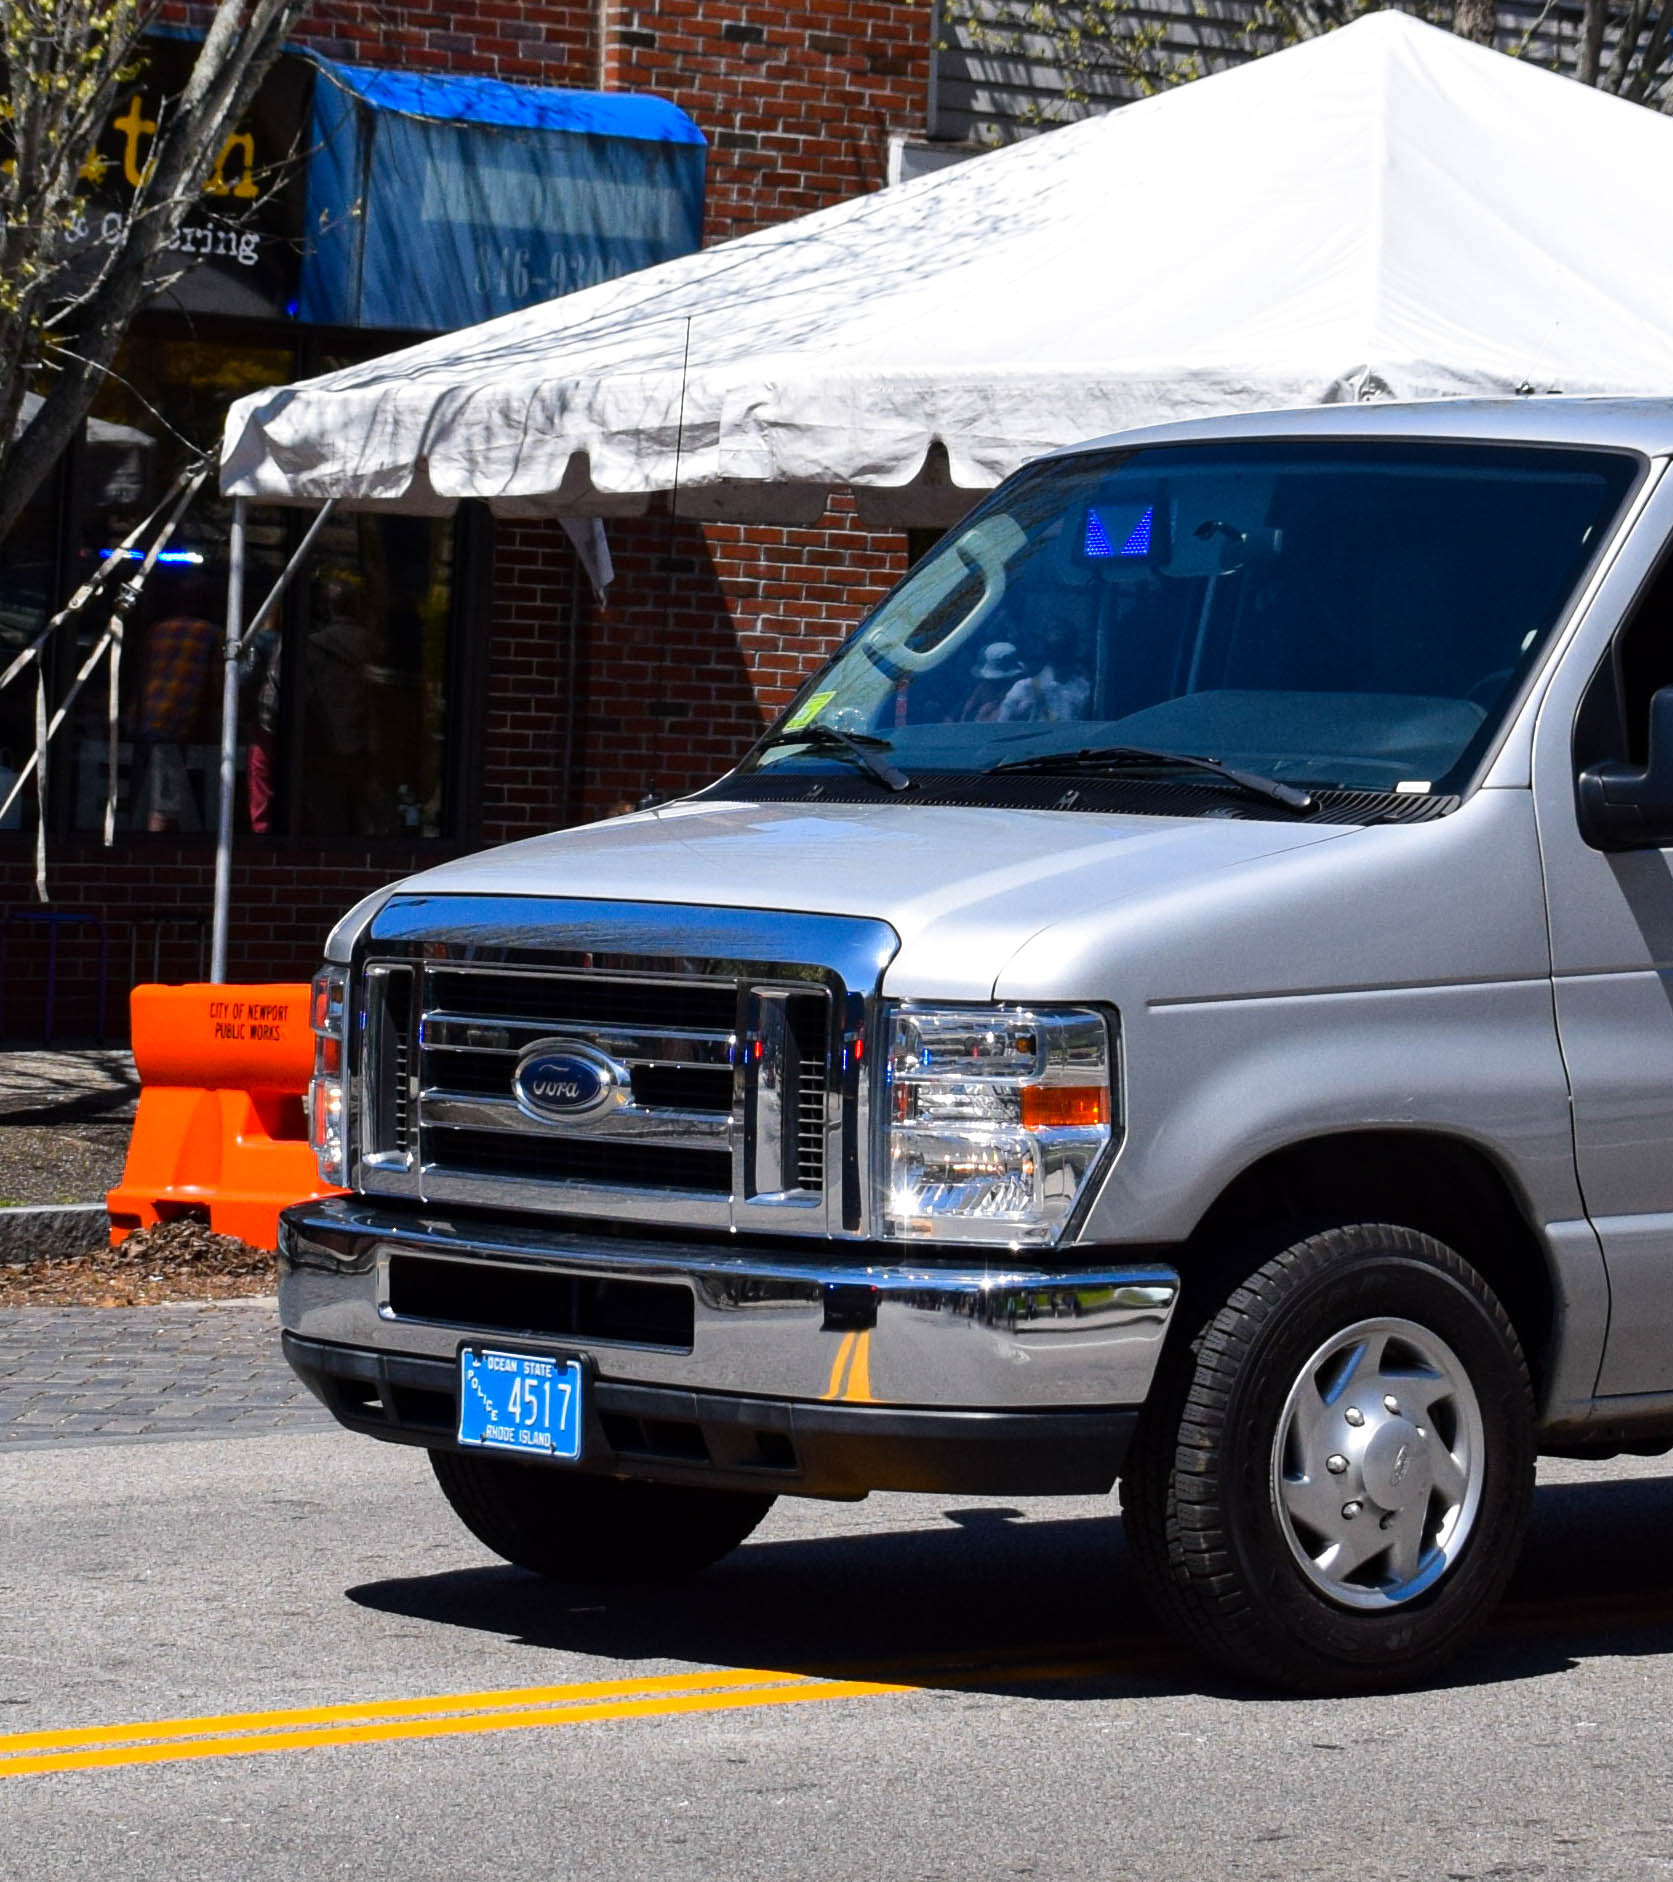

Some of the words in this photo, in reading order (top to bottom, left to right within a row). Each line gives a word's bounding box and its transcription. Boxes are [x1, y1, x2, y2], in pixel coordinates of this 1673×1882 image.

[210, 1002, 229, 1018] CITY
[233, 1003, 245, 1019] OF
[248, 1004, 288, 1021] NEWPORT
[215, 1022, 245, 1039] PUBLIC
[250, 1024, 280, 1041] WORKS
[487, 1356, 518, 1372] OCEAN
[523, 1361, 553, 1378] STATE
[467, 1370, 498, 1421] POLICE
[508, 1377, 572, 1430] 4517
[486, 1424, 515, 1442] RHODE
[519, 1430, 552, 1447] ISLAND
